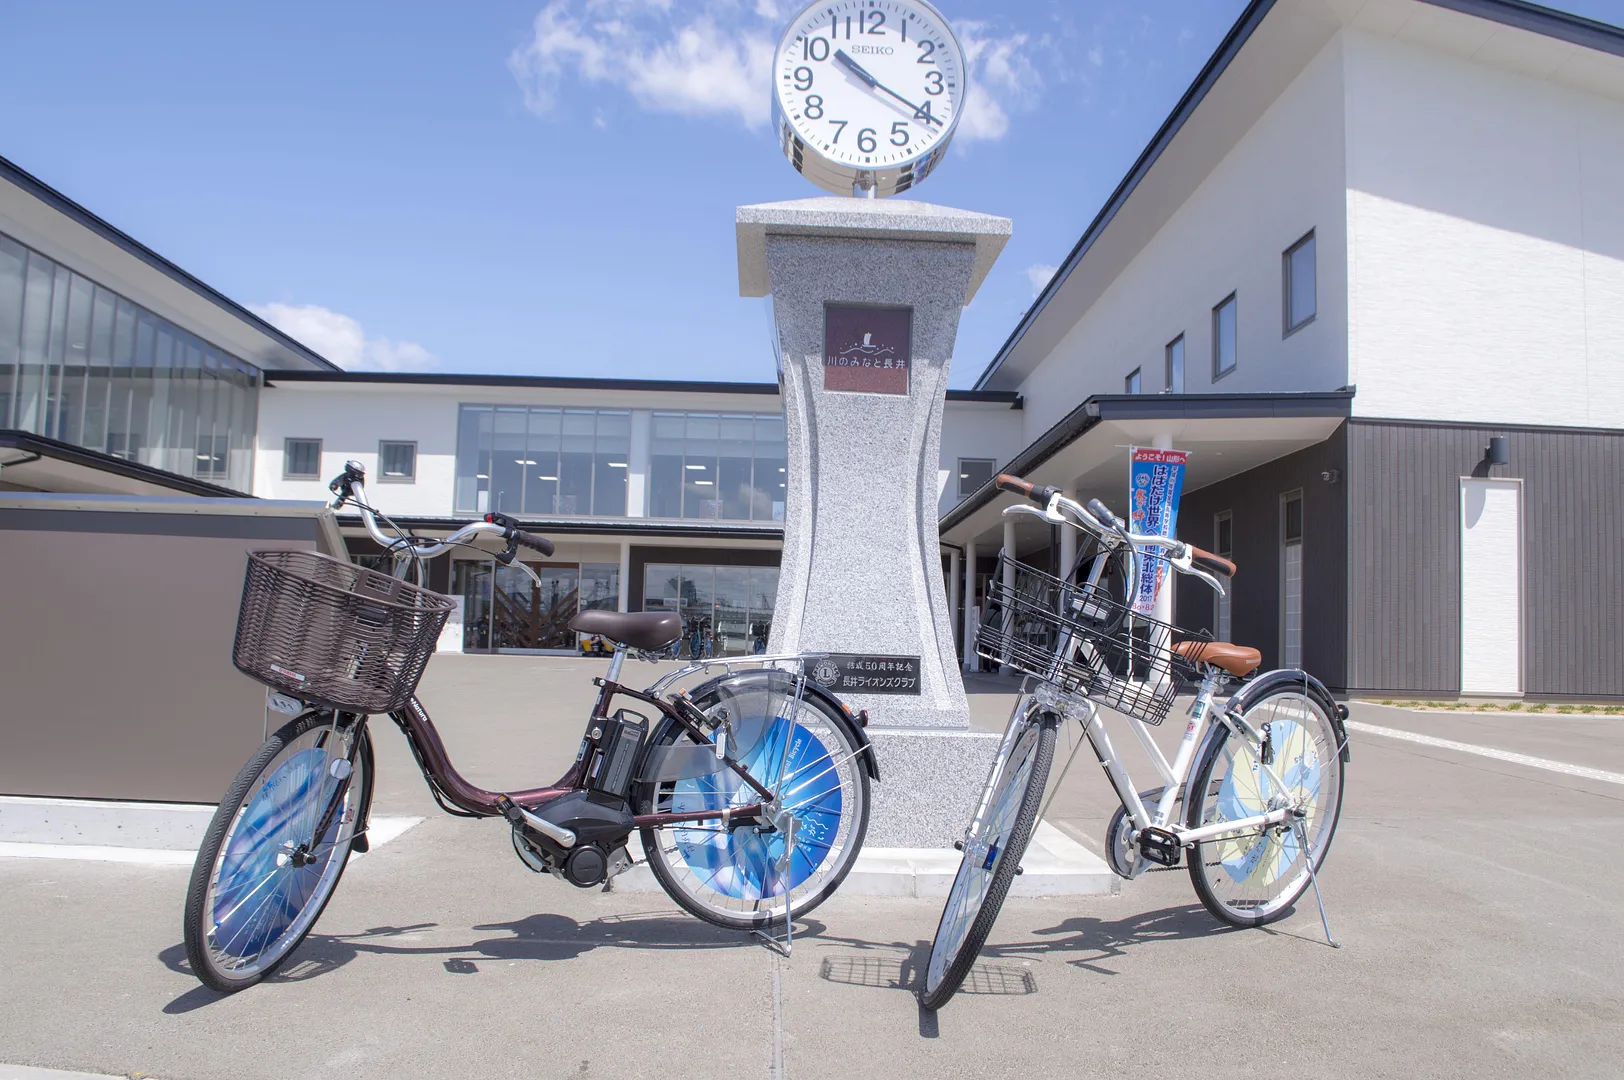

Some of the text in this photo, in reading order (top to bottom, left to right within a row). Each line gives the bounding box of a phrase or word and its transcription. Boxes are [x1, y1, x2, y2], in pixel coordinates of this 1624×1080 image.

[832, 15, 851, 40] 11
[859, 10, 886, 35] 12
[901, 18, 907, 43] 1
[803, 36, 830, 61] 10
[851, 44, 894, 55] SEIKO
[916, 39, 936, 64] 2
[793, 66, 814, 91] 9
[924, 70, 944, 95] 3
[803, 94, 824, 119] 8
[913, 100, 931, 124] 4
[828, 120, 848, 144] 7
[857, 128, 877, 153] 6
[889, 121, 909, 146] 5
[827, 355, 906, 369] 川のみなと長井
[846, 661, 913, 672] 結成50周年記念
[842, 675, 916, 688] 長井ライオンズクラブ
[788, 738, 803, 760] Bicycle
